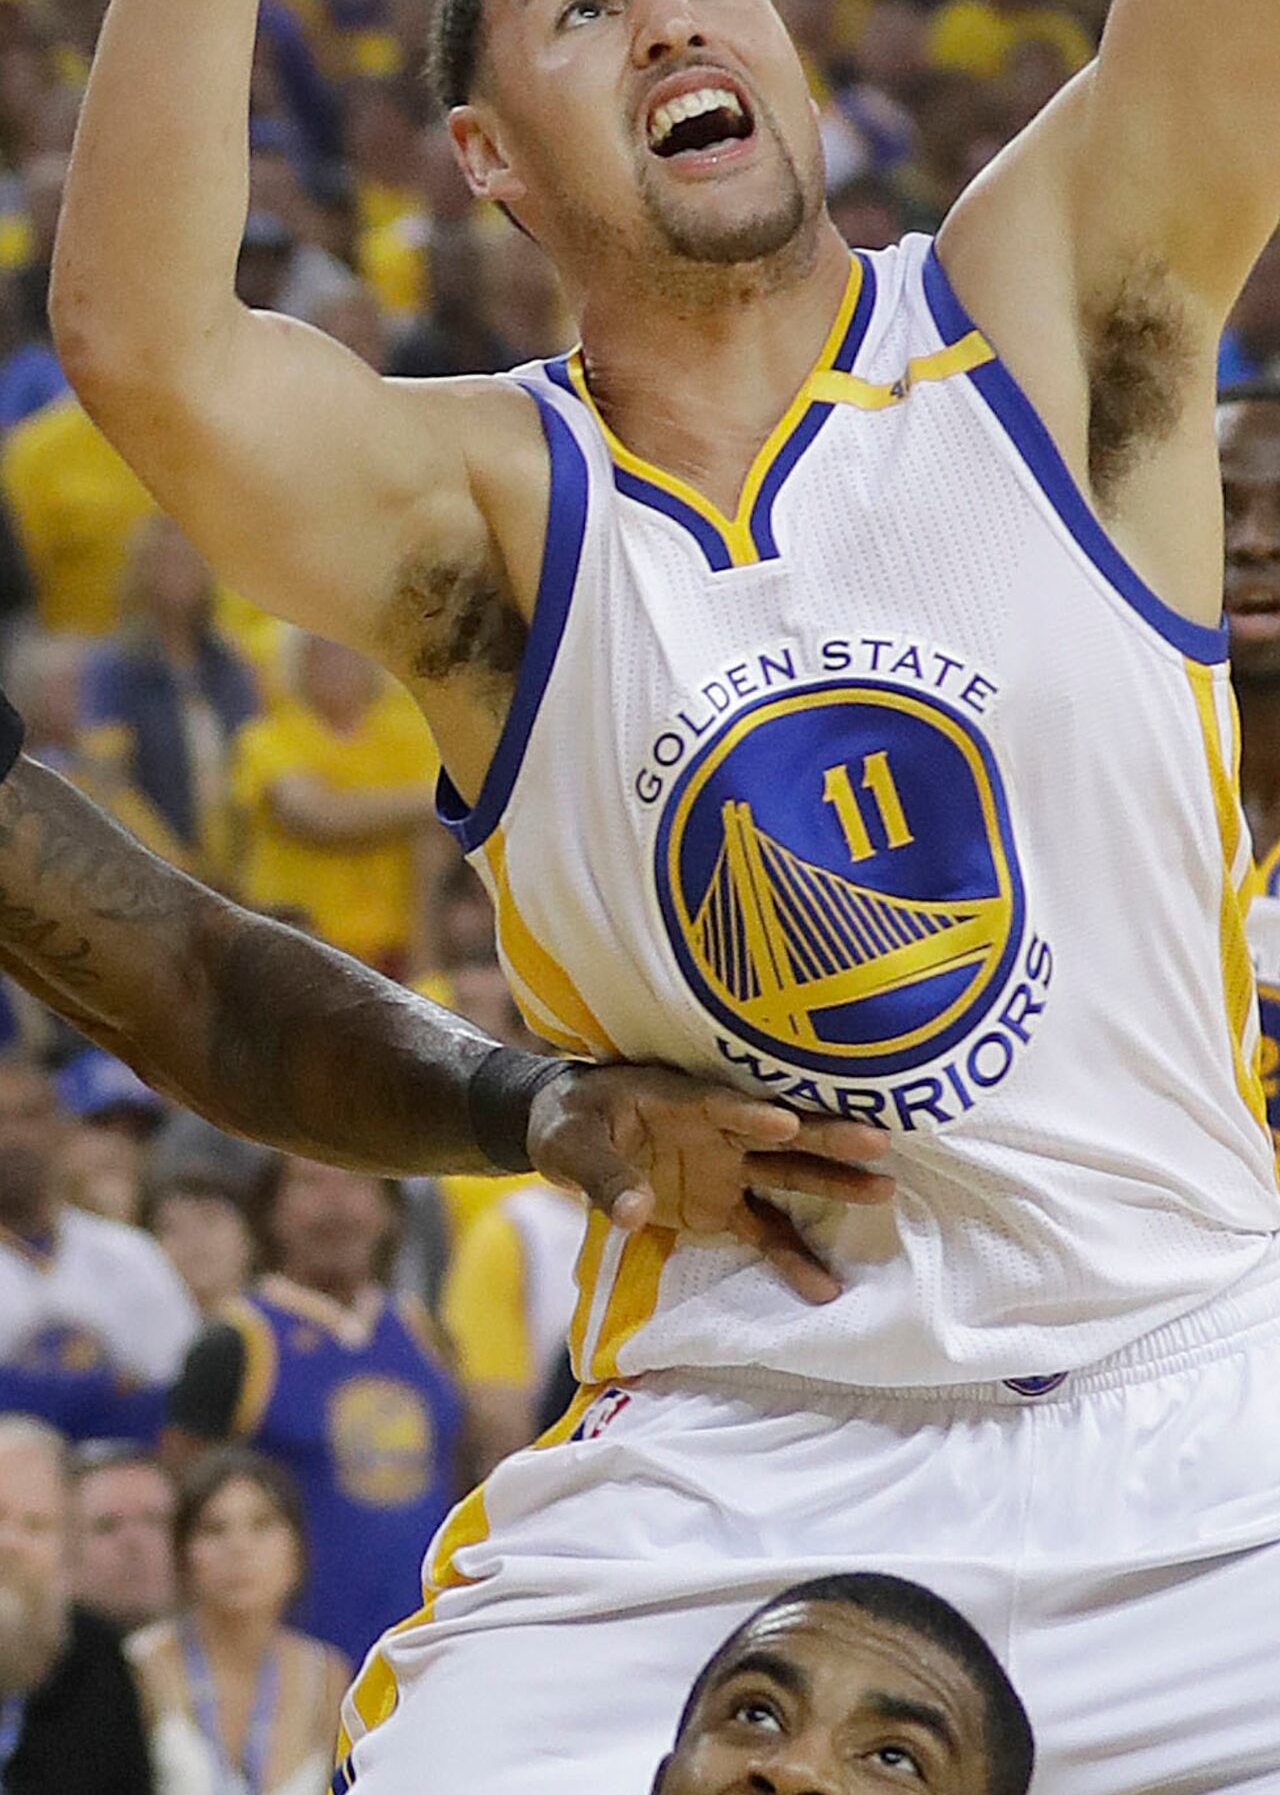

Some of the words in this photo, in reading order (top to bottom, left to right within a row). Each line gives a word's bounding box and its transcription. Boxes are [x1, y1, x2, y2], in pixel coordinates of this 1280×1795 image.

[635, 648, 797, 805] GOLDEN
[821, 639, 999, 715] STATE
[822, 750, 915, 863] 11
[716, 932, 1055, 1132] WARRIORS
